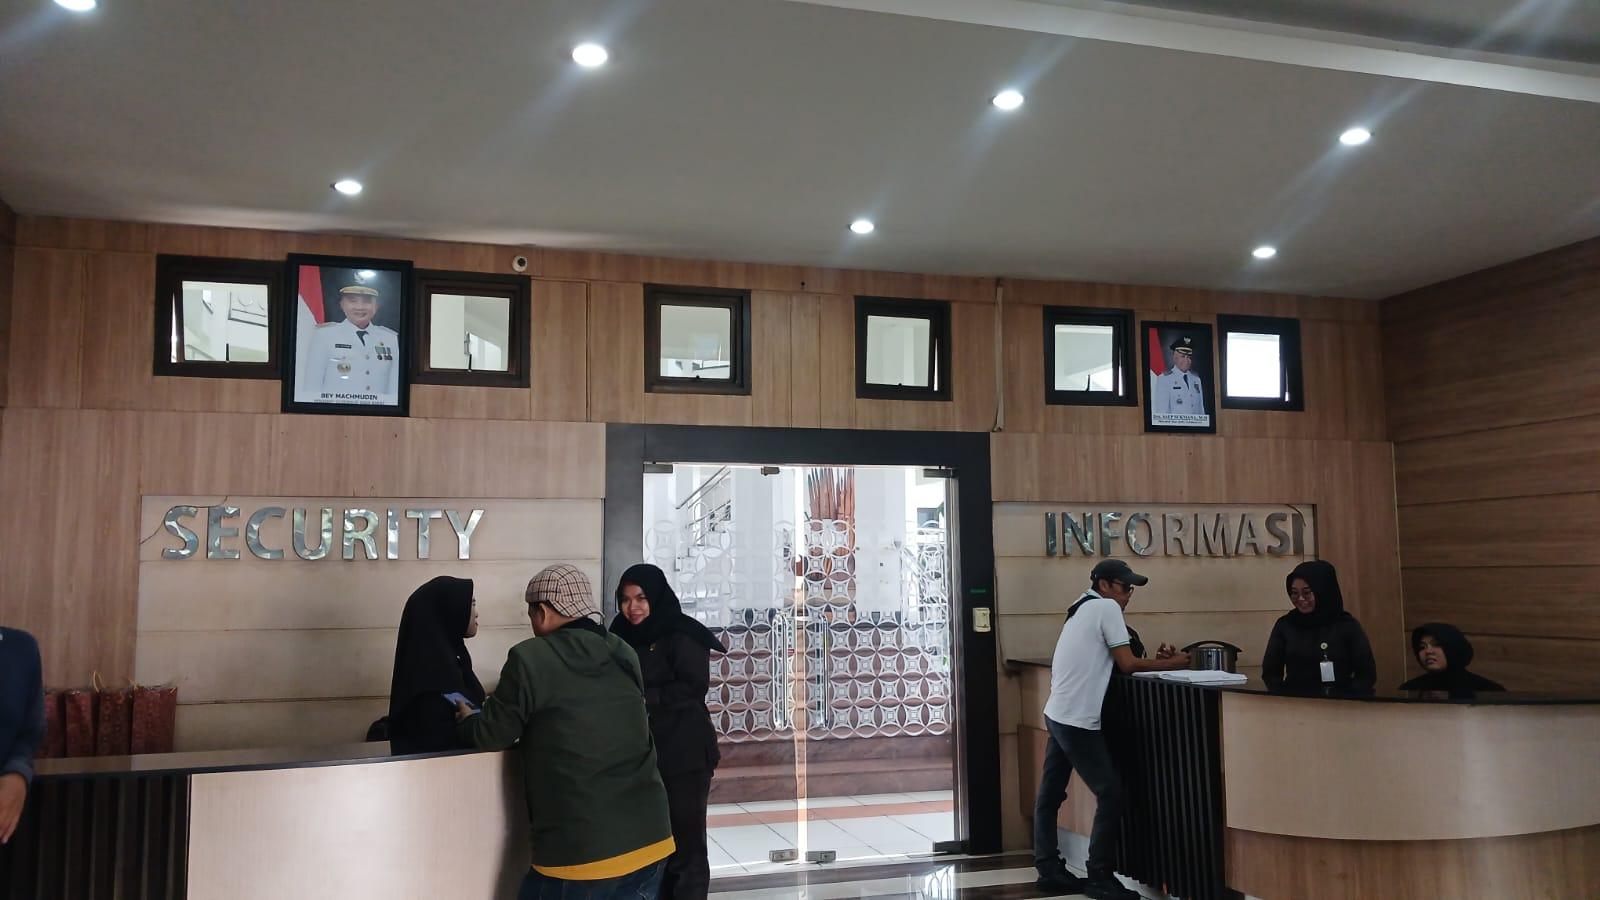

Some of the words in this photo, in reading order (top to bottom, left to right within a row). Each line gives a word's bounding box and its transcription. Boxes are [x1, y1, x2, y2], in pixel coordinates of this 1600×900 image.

[335, 393, 378, 401] MACHMUDIN
[161, 505, 485, 561] SECURITY
[1045, 511, 1305, 558] INFORMASI
